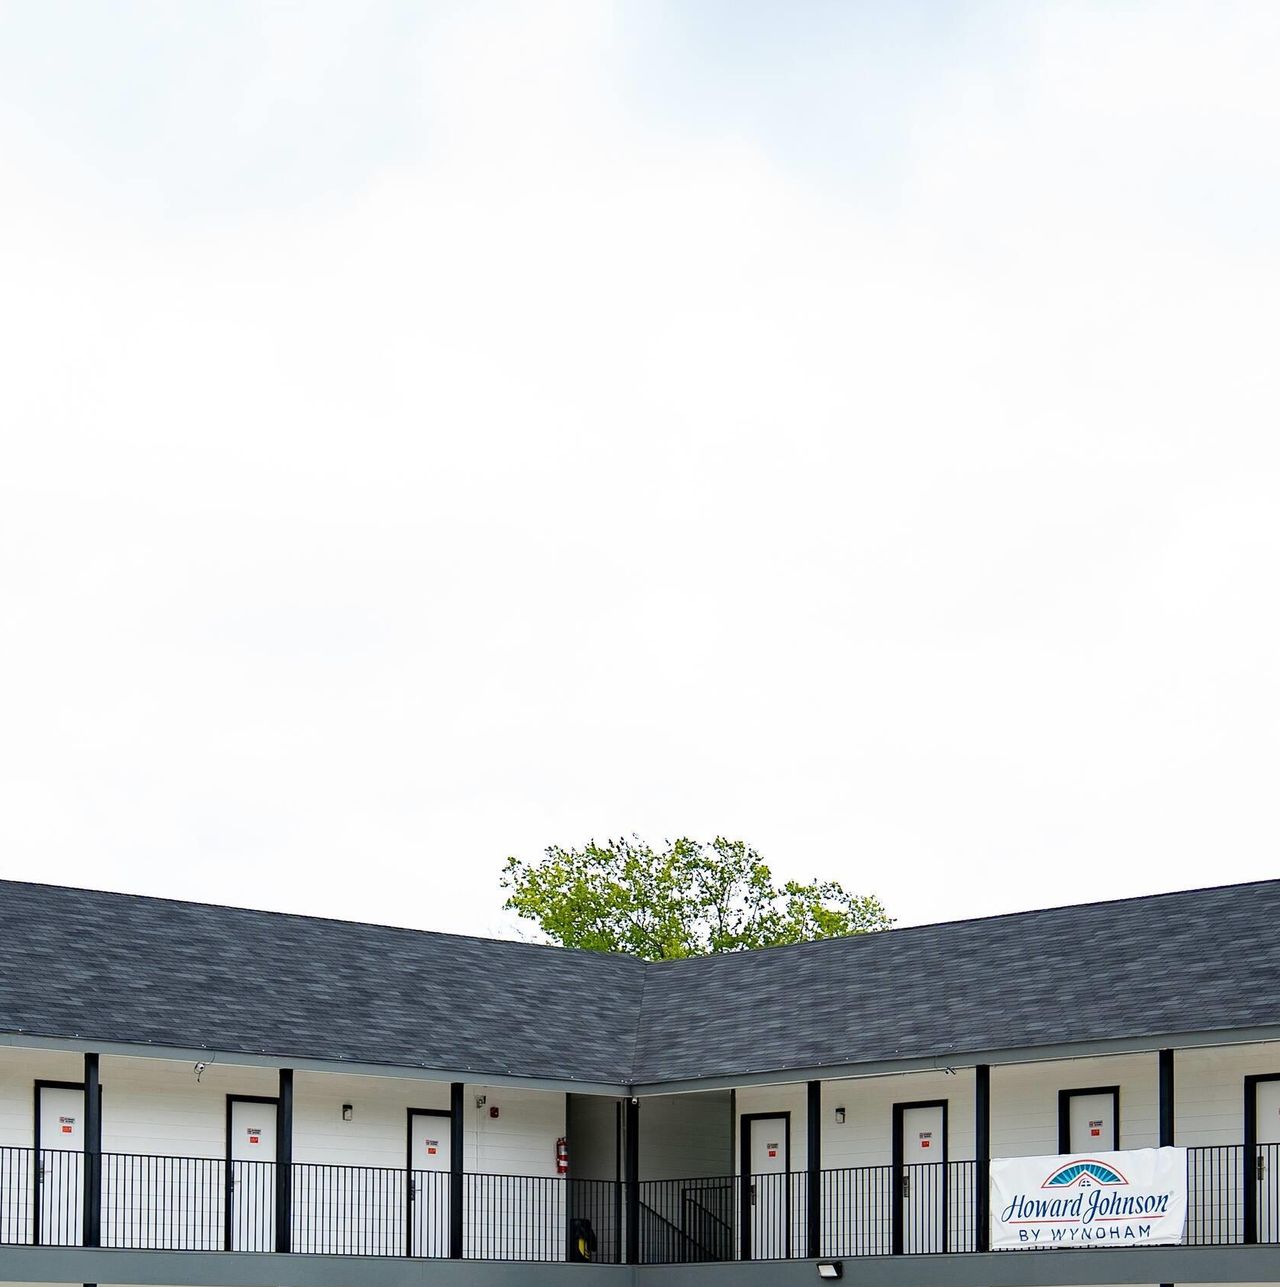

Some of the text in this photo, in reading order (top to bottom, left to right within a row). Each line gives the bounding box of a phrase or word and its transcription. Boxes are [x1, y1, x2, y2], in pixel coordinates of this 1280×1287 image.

[1001, 1189, 1169, 1224] Howard Johnson
[1020, 1229, 1041, 1242] BY
